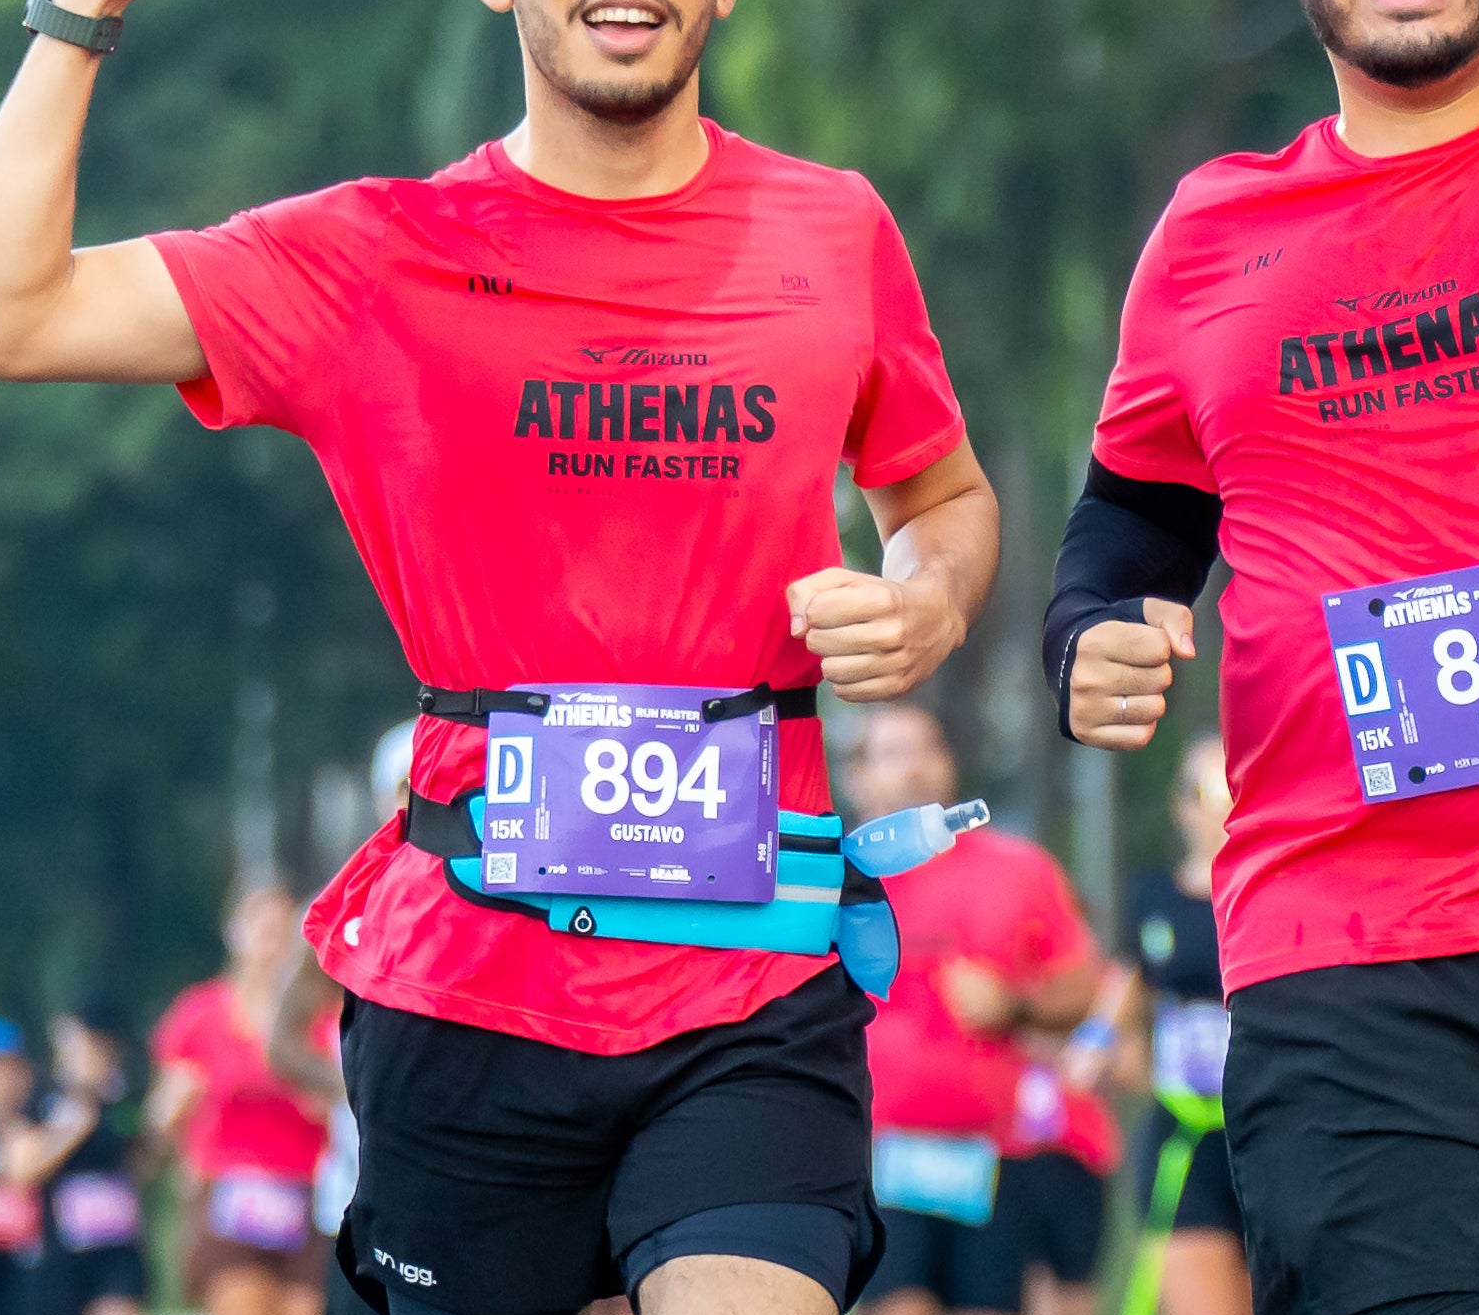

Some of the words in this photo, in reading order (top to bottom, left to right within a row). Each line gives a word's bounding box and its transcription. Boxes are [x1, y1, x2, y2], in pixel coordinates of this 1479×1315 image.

[617, 347, 708, 366] Mizuno
[513, 379, 777, 443] ATHENAS
[1318, 388, 1387, 424] RUN
[548, 452, 615, 477] RUN
[624, 455, 740, 480] FASTER
[1383, 591, 1473, 628] ATHENAS
[1346, 653, 1378, 706] D
[542, 704, 633, 728] ATHENAS
[635, 707, 659, 719] RUN
[660, 708, 701, 721] FASTER
[1355, 726, 1395, 752] 15K
[497, 744, 524, 796] D
[580, 737, 728, 820] 894
[489, 819, 525, 840] 15K
[610, 823, 685, 845] GUSTAVO
